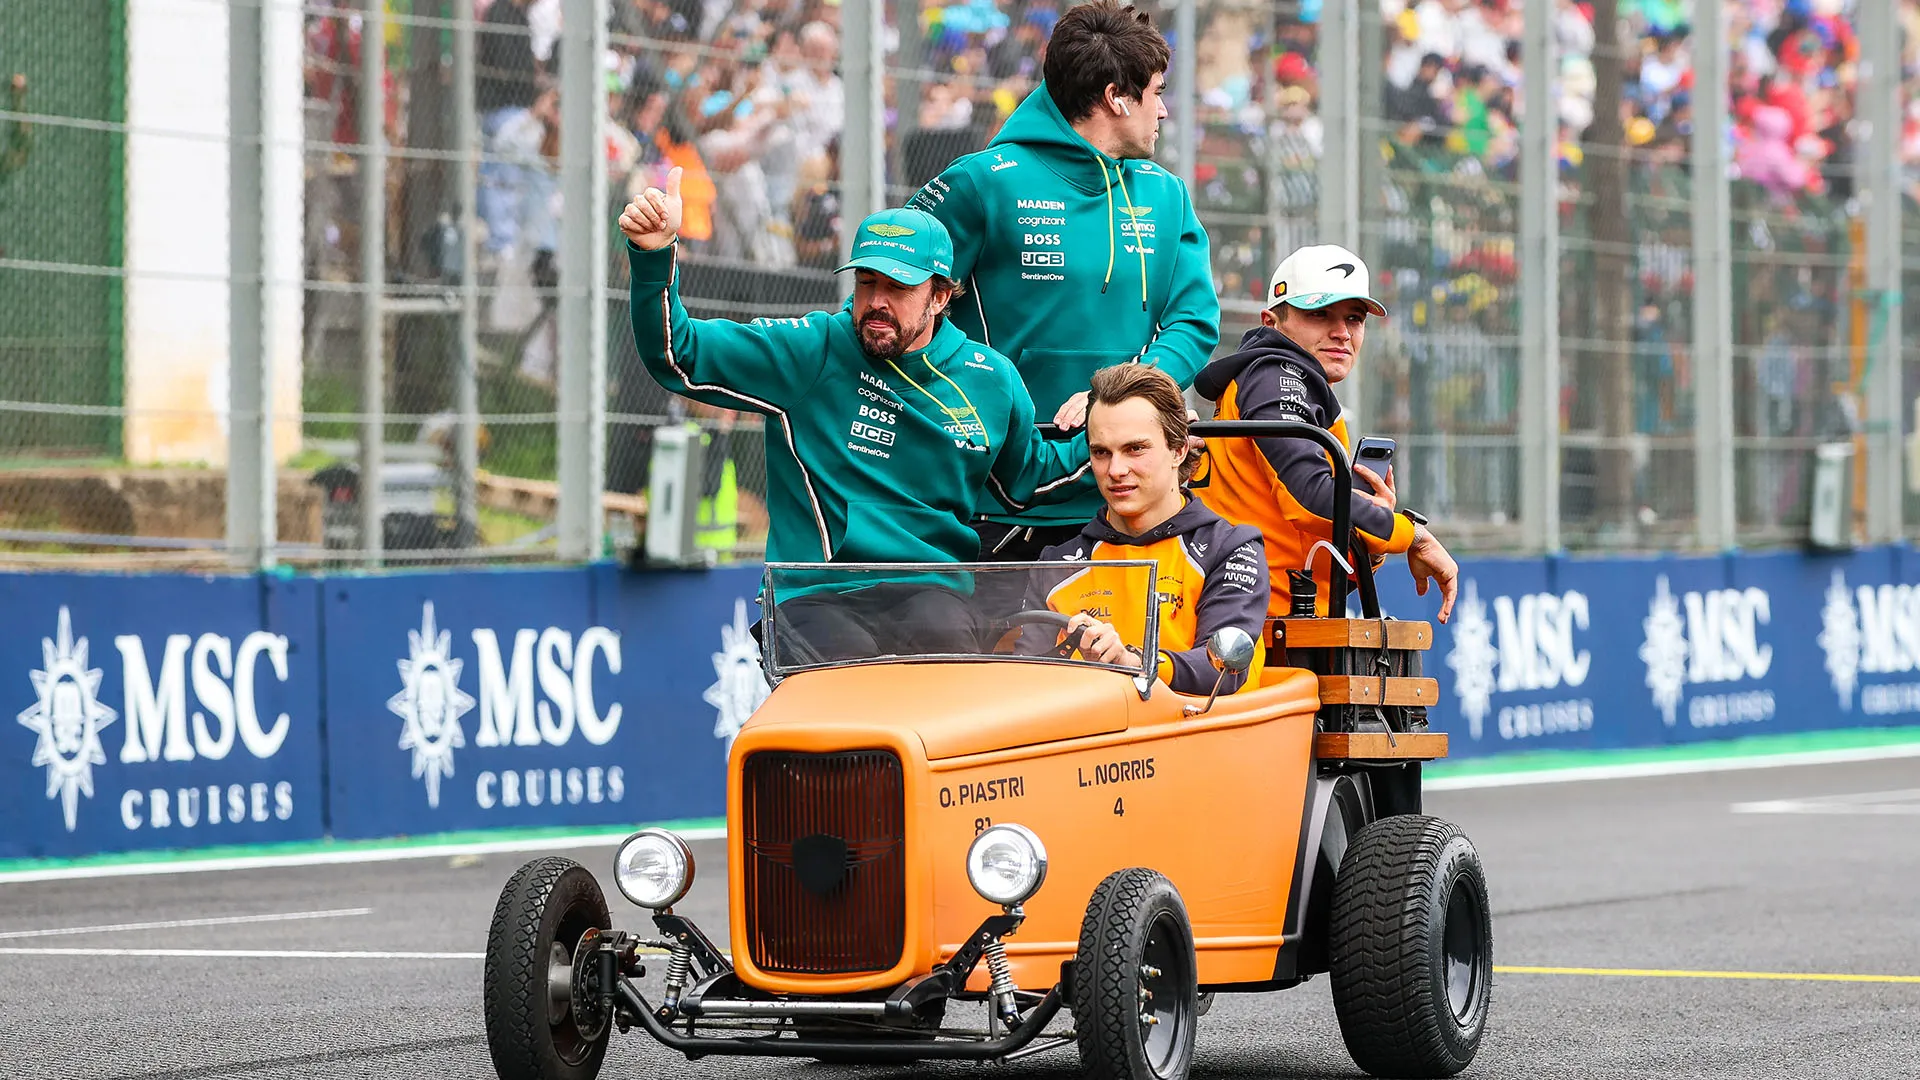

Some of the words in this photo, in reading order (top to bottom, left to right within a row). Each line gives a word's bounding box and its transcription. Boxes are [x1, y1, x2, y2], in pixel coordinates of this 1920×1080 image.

[1017, 199, 1065, 210] MAADEN
[1017, 216, 1066, 227] cognizant
[900, 243, 916, 254] TEAM
[1024, 233, 1061, 245] BOSS
[1022, 252, 1064, 266] JCB
[1021, 272, 1065, 281] SentinelOne
[857, 387, 905, 412] cognizant
[859, 404, 897, 425] BOSS
[851, 422, 895, 446] JCB
[847, 441, 890, 459] SentinelOne
[1223, 572, 1257, 586] ARROW
[1225, 562, 1258, 575] ECOLAB
[1684, 586, 1773, 684] MSC
[1856, 583, 1920, 673] MS
[1493, 589, 1591, 692] MSC
[114, 631, 291, 763] MSC
[471, 626, 623, 748] MSC
[1078, 767, 1092, 788] L.
[1095, 757, 1155, 786] NORRIS
[476, 765, 625, 810] CRUISES
[939, 787, 956, 808] O.
[959, 776, 1025, 806] PIASTRI
[120, 780, 294, 831] CRUISES
[1113, 797, 1125, 817] 4
